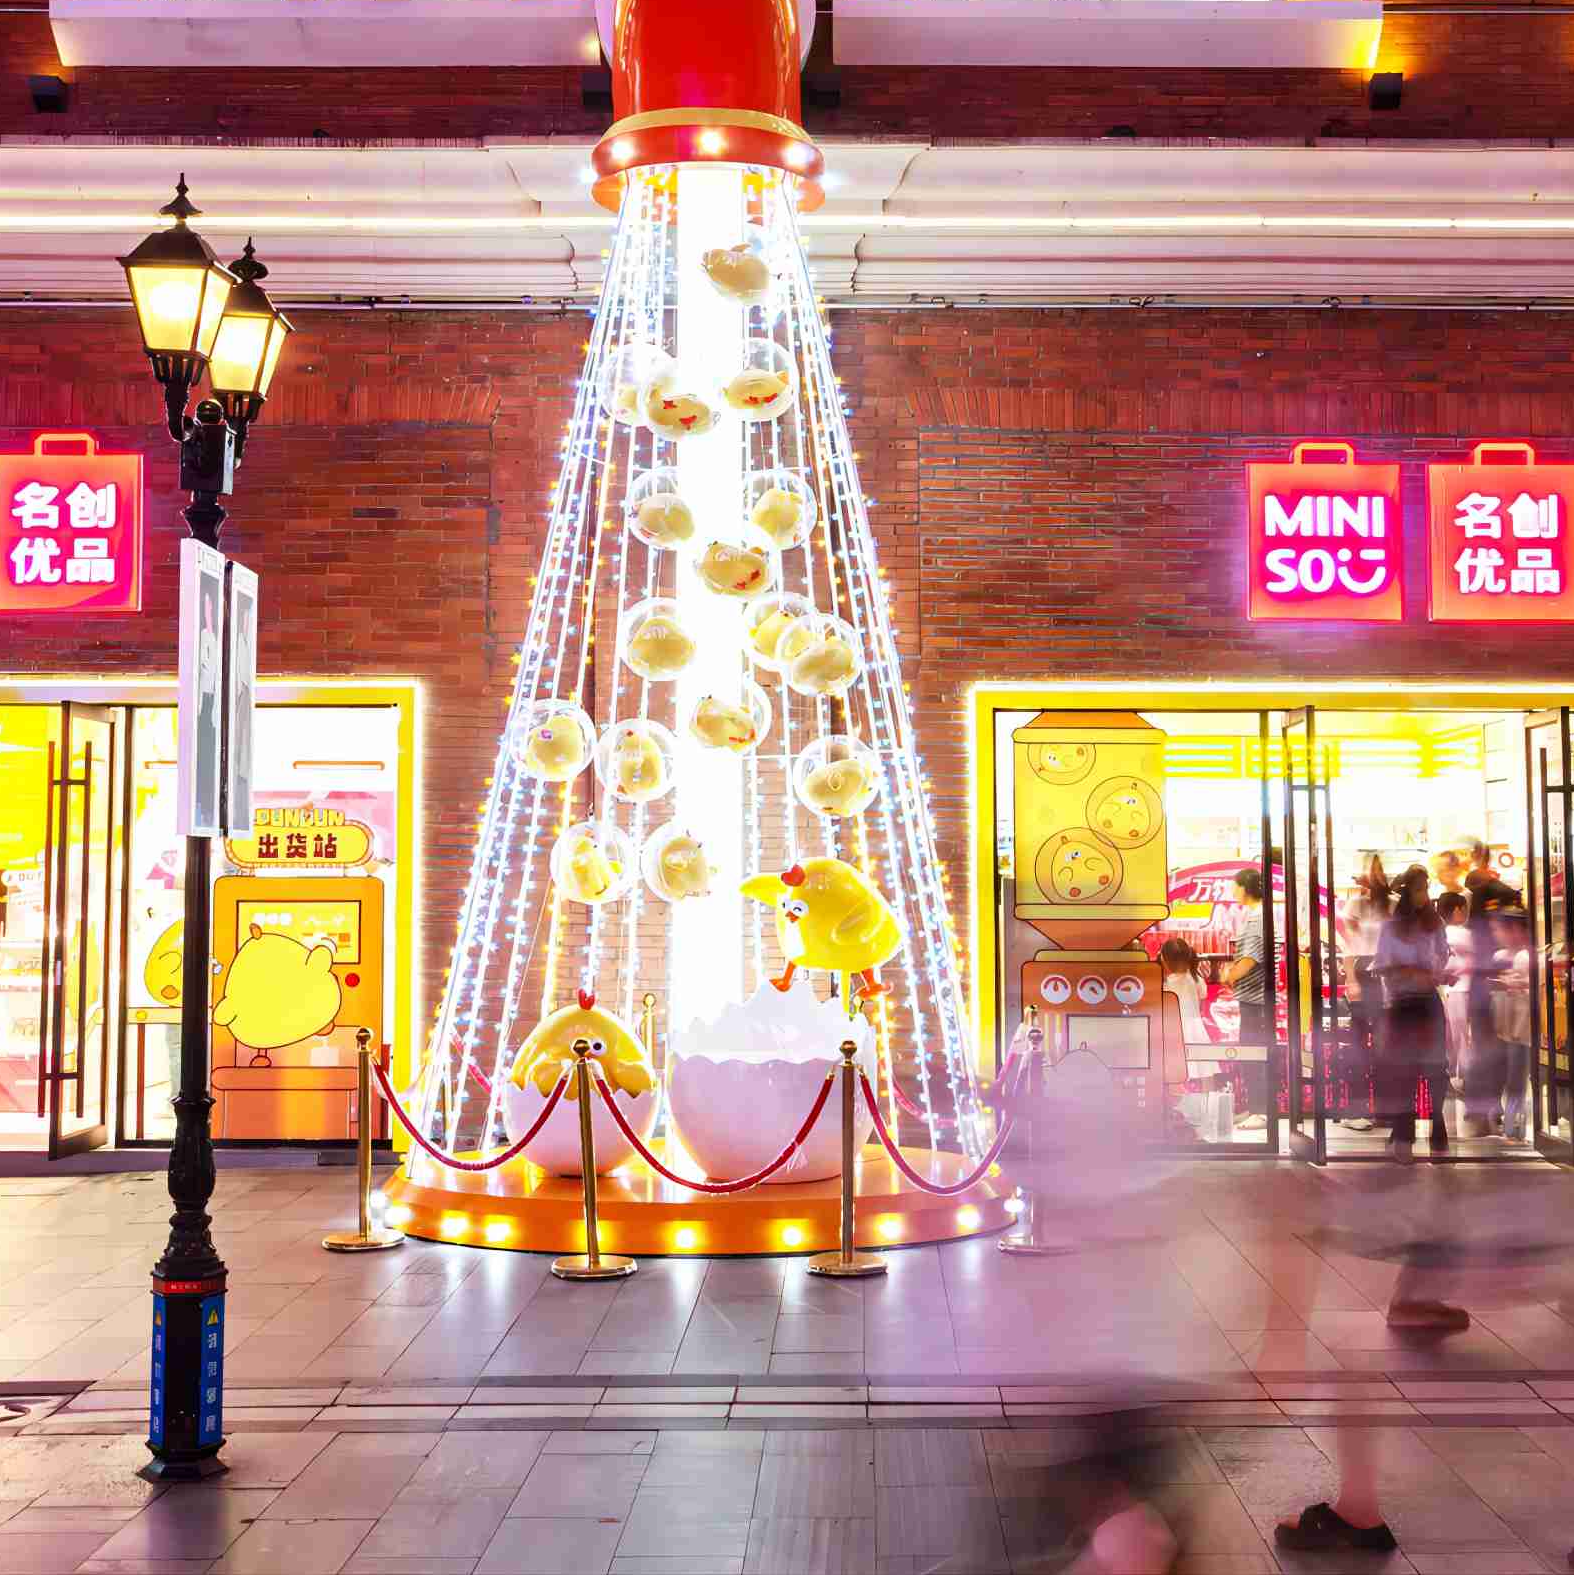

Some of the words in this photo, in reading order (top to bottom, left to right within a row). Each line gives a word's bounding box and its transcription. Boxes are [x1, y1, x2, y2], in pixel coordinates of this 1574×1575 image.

[11, 481, 117, 529] 名创
[1264, 494, 1386, 538] MINI
[1453, 492, 1559, 539] 名创
[9, 537, 116, 583] 优品
[1453, 547, 1561, 594] 优品
[258, 833, 337, 859] 出货站
